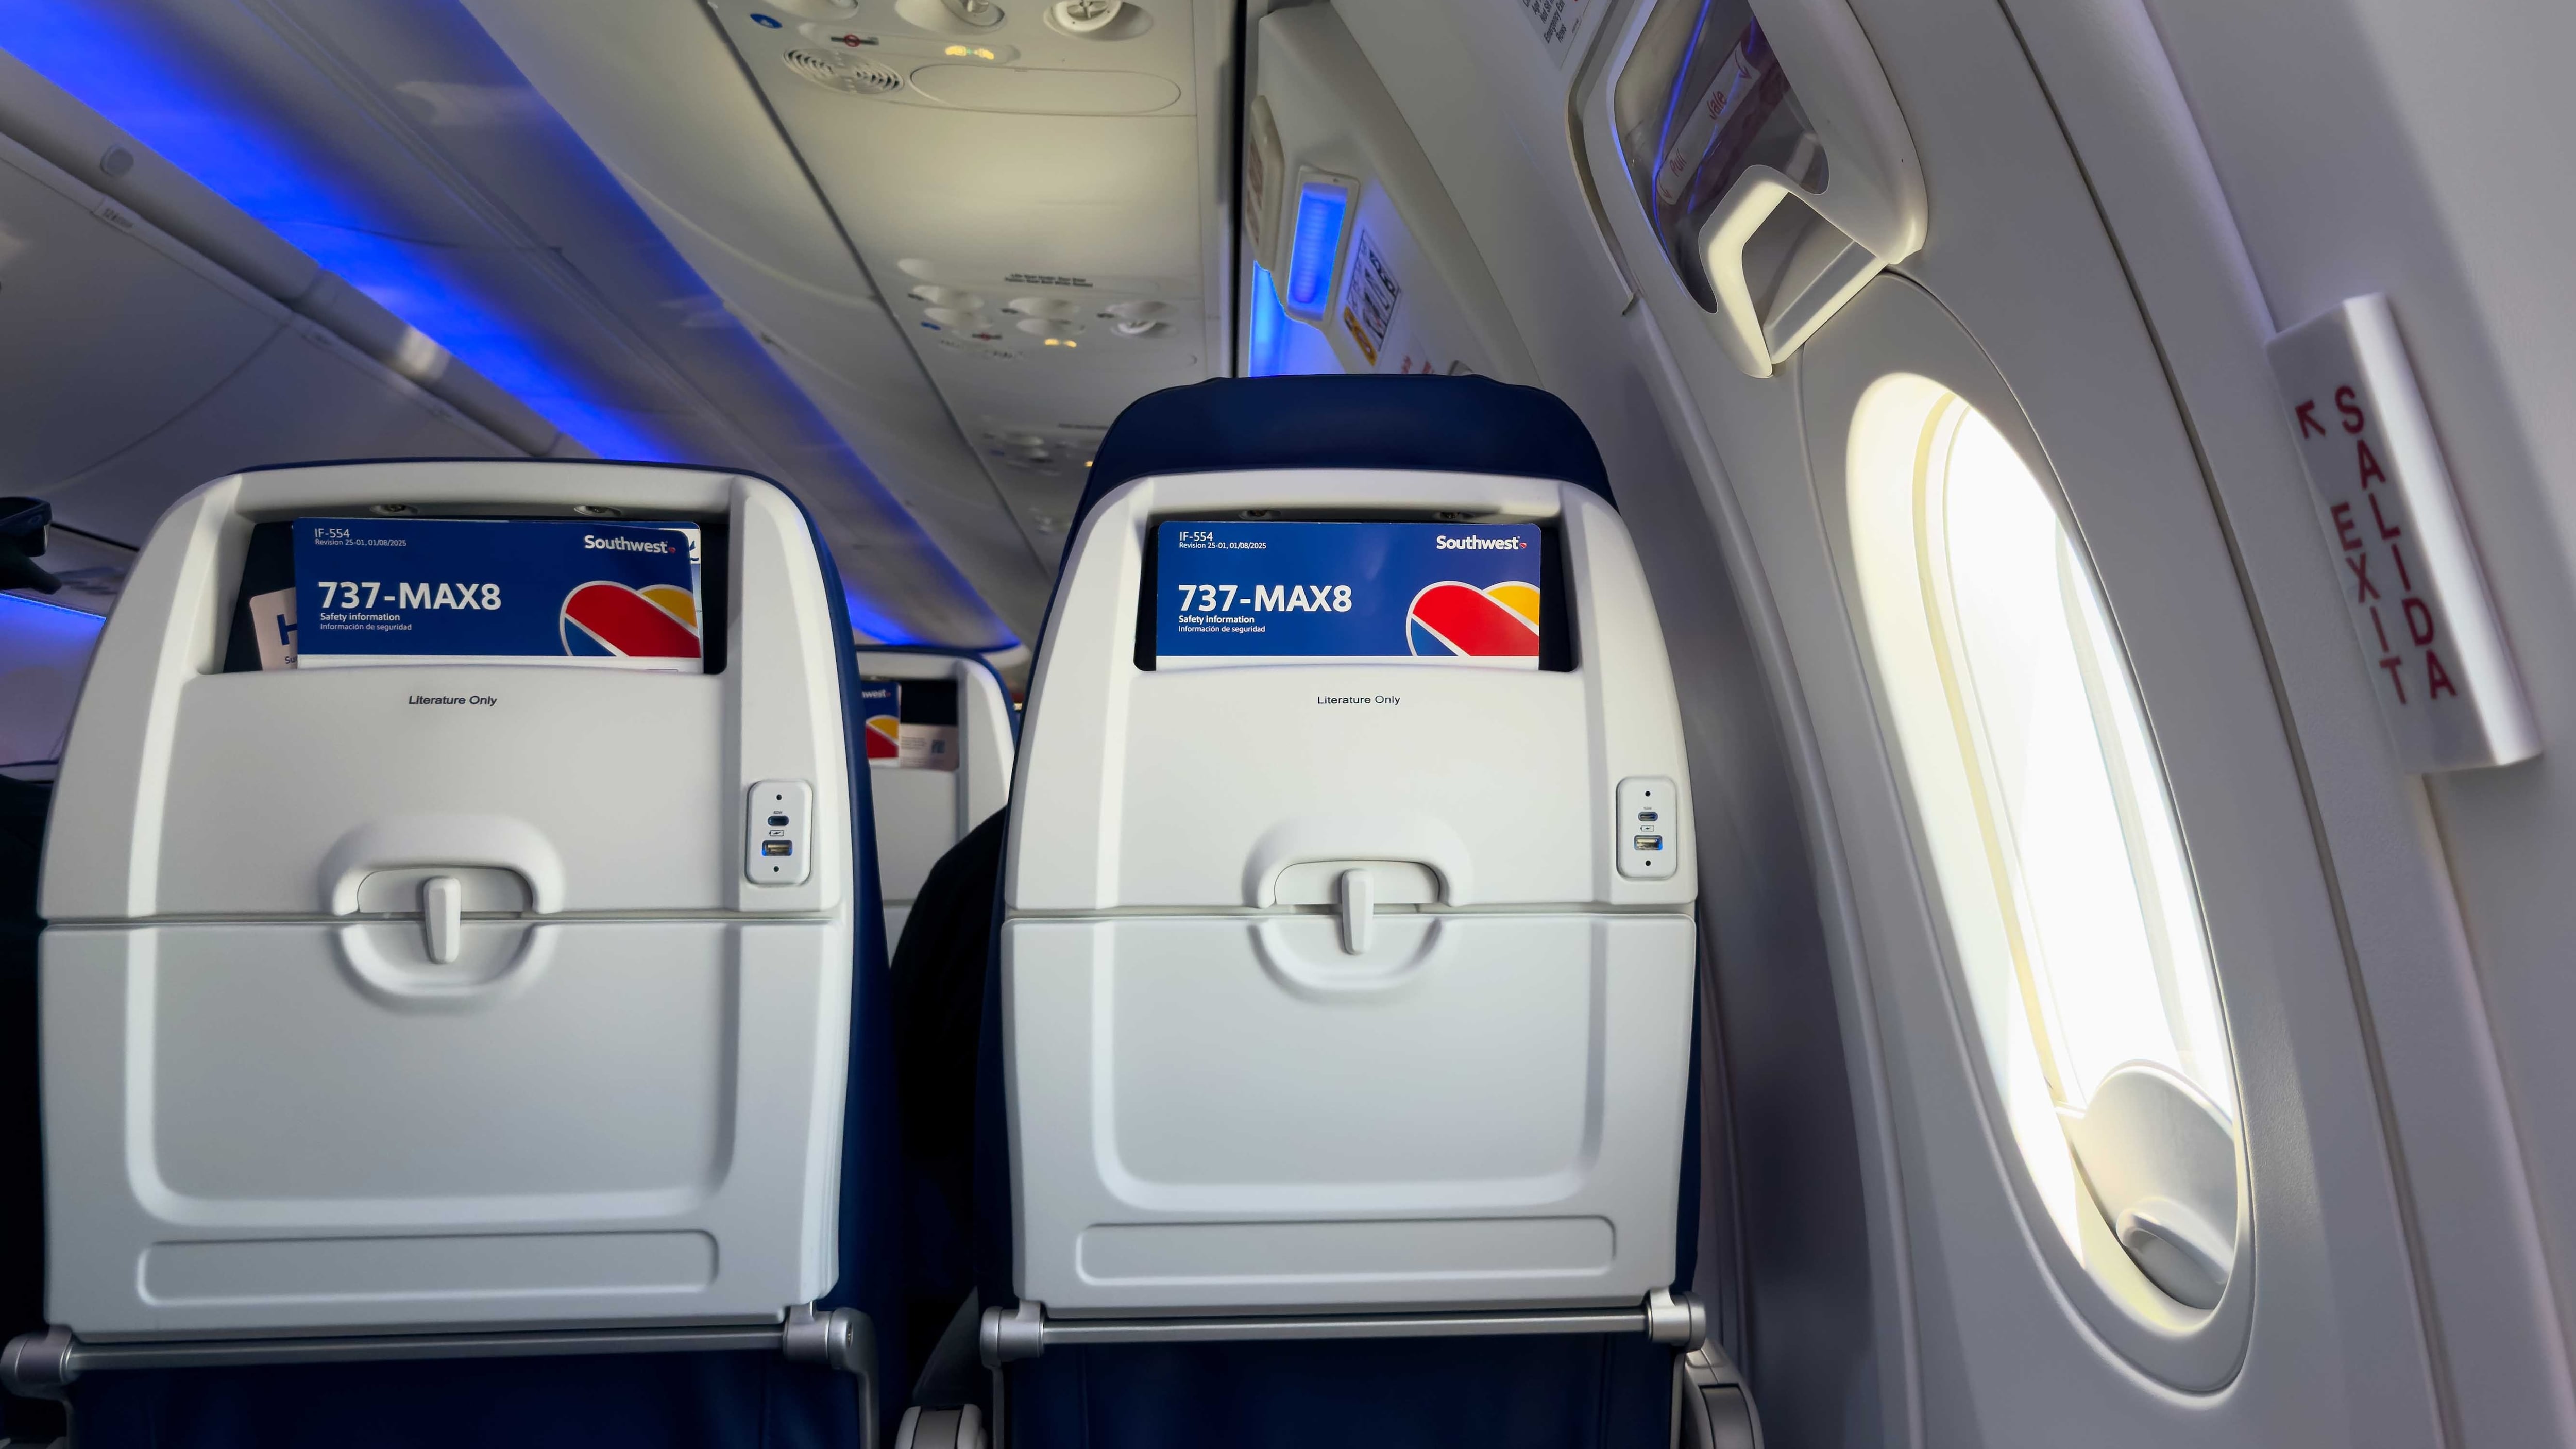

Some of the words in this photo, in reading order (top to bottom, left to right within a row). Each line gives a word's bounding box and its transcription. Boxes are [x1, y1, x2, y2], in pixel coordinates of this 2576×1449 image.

[1544, 9, 1561, 44] Emergency
[1556, 23, 1567, 43] Rows
[1670, 148, 1687, 177] Pull
[315, 528, 350, 538] IF-554
[1179, 531, 1213, 541] IF-554
[584, 534, 668, 553] Southwest
[1436, 535, 1519, 550] Southwest
[2335, 385, 2457, 700] SALIDA
[318, 581, 502, 610] 737-MAX8
[1178, 584, 1352, 612] 737-MAX8
[2330, 501, 2406, 705] EXIT
[320, 612, 347, 621] Safety
[349, 613, 400, 621] information
[1179, 615, 1204, 625] Safety
[377, 624, 412, 632] seguridad
[1232, 625, 1265, 633] seguridad
[409, 696, 466, 704] Literature
[469, 696, 497, 706] Only
[1375, 695, 1400, 705] Only
